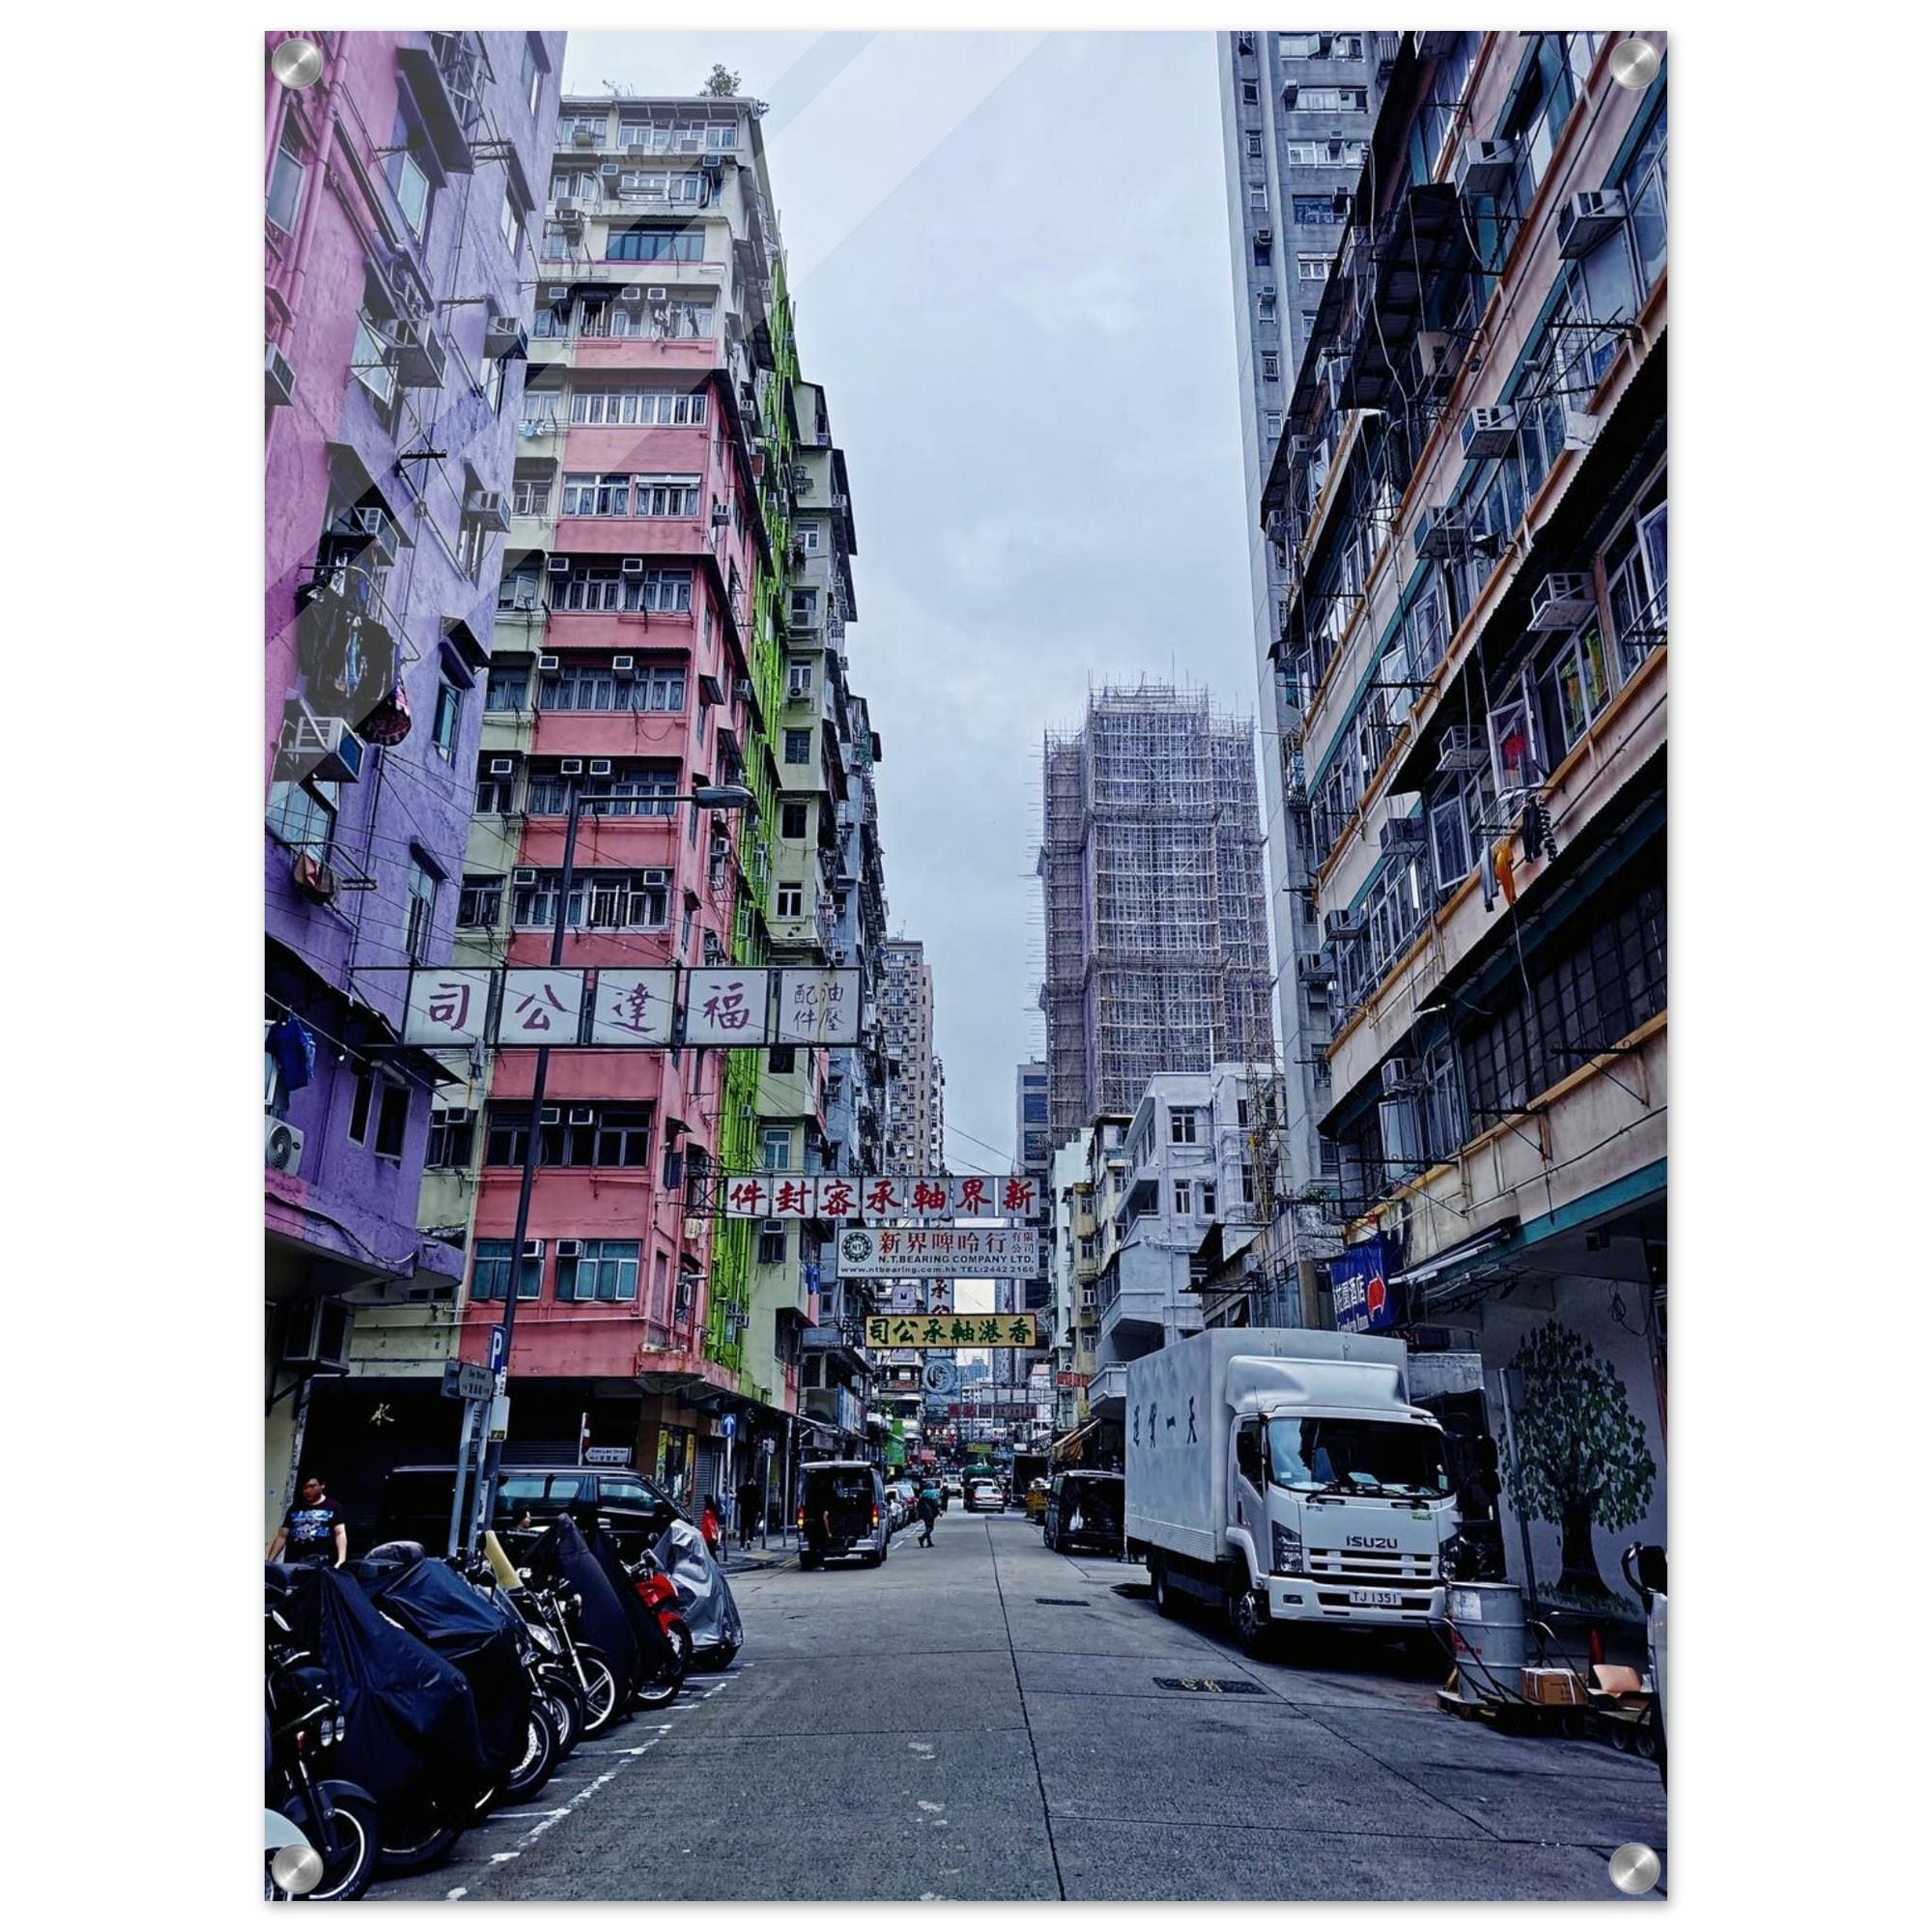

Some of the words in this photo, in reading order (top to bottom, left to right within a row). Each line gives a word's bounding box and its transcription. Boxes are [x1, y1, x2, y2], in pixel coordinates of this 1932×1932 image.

[840, 1265, 956, 1274] www.ntbearing.com.hk
[869, 1318, 1032, 1344] 香港軸承公司
[1346, 1535, 1398, 1548] ISUZU
[1352, 1591, 1367, 1602] TJ
[1371, 1592, 1397, 1604] 1351
